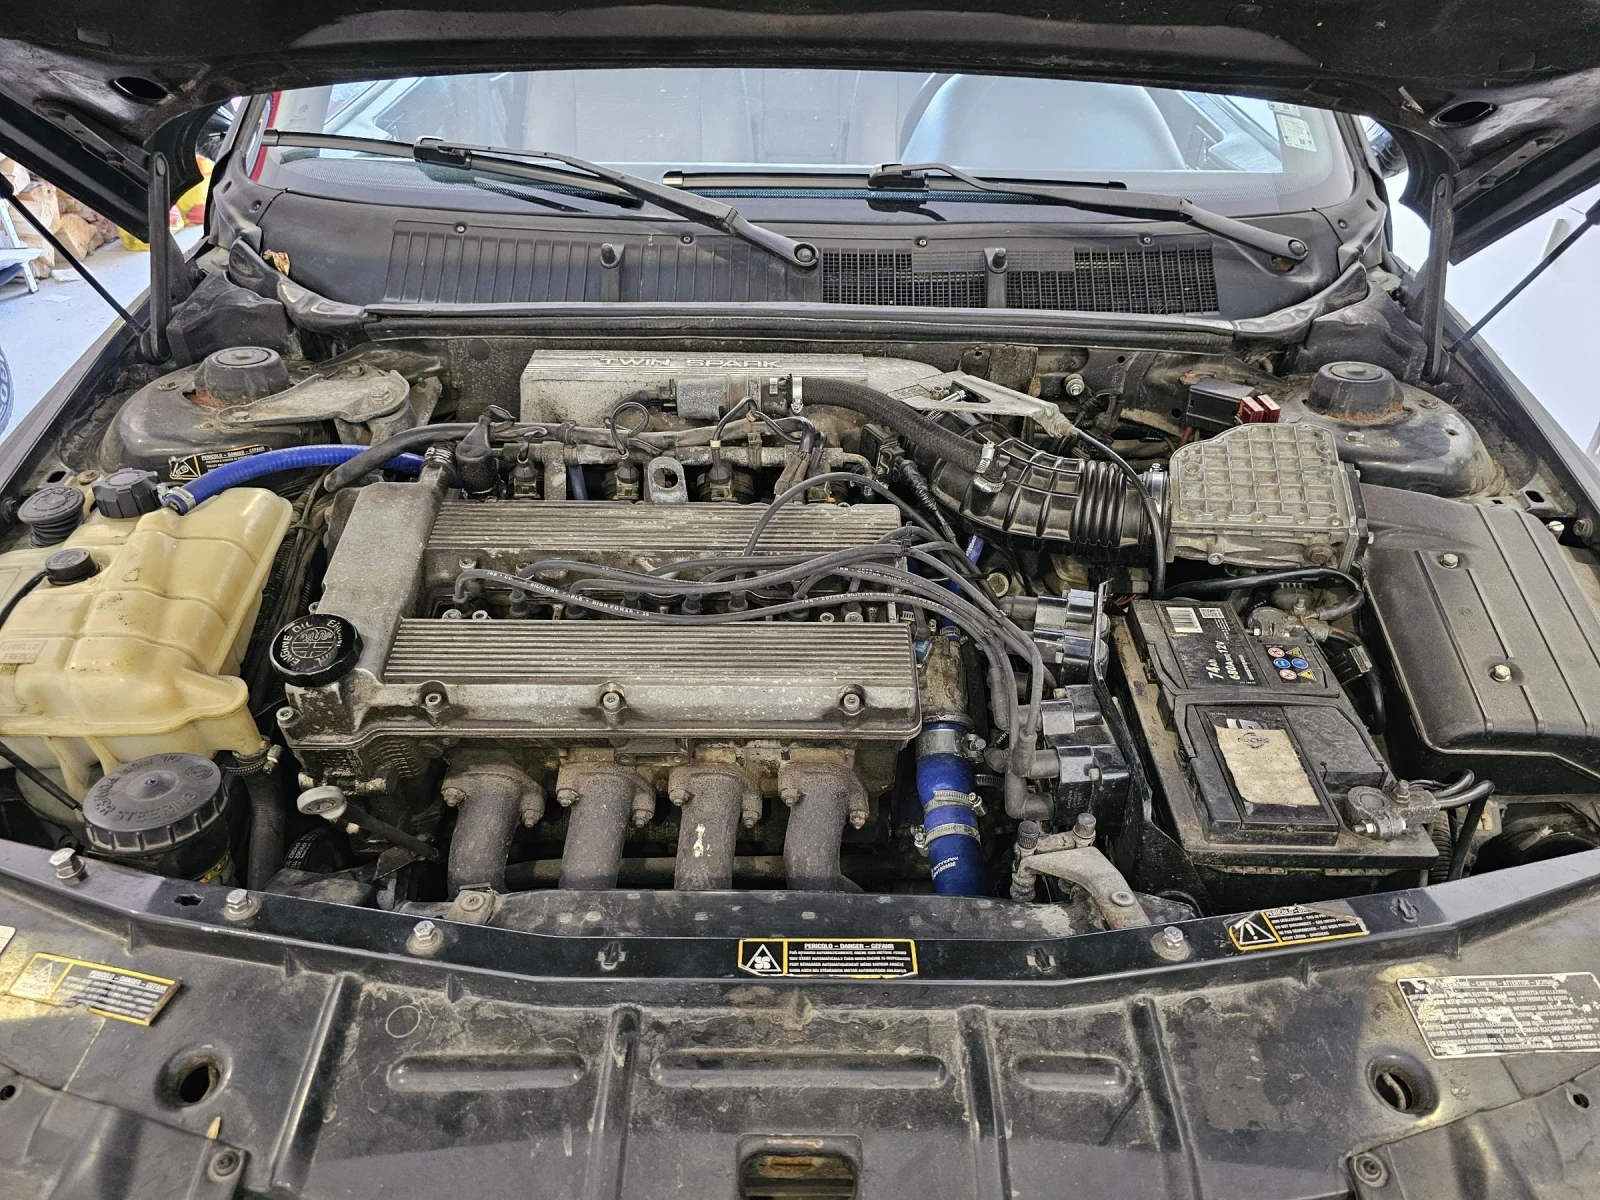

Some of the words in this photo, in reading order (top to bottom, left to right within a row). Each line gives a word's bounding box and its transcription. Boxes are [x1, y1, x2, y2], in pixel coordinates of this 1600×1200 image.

[600, 358, 671, 367] TWIN
[685, 358, 783, 368] SPARK
[530, 583, 559, 595] SILICONE
[591, 601, 609, 609] HIGH
[609, 605, 635, 614] POWER
[291, 621, 313, 633] OIL
[279, 634, 301, 667] ENGINE
[93, 776, 120, 817] POWER
[113, 791, 199, 823] STEERING
